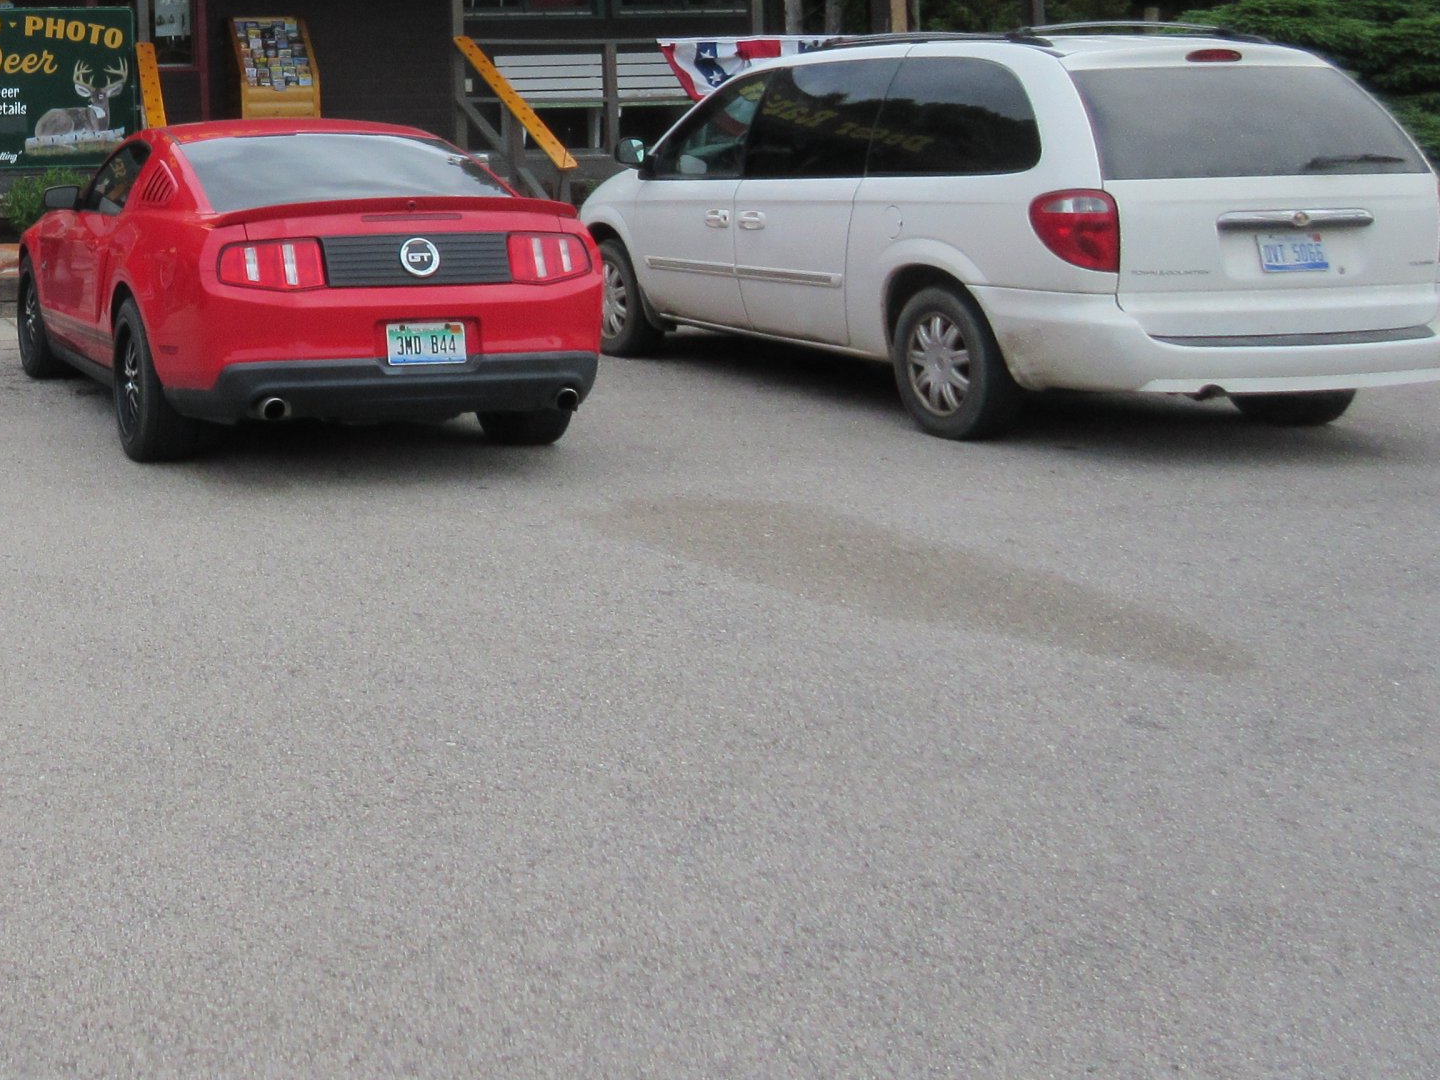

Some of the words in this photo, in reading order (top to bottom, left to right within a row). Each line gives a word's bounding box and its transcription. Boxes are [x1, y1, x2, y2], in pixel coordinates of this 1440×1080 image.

[24, 15, 124, 50] PHOTO
[407, 252, 431, 263] GT
[430, 333, 456, 354] B44
